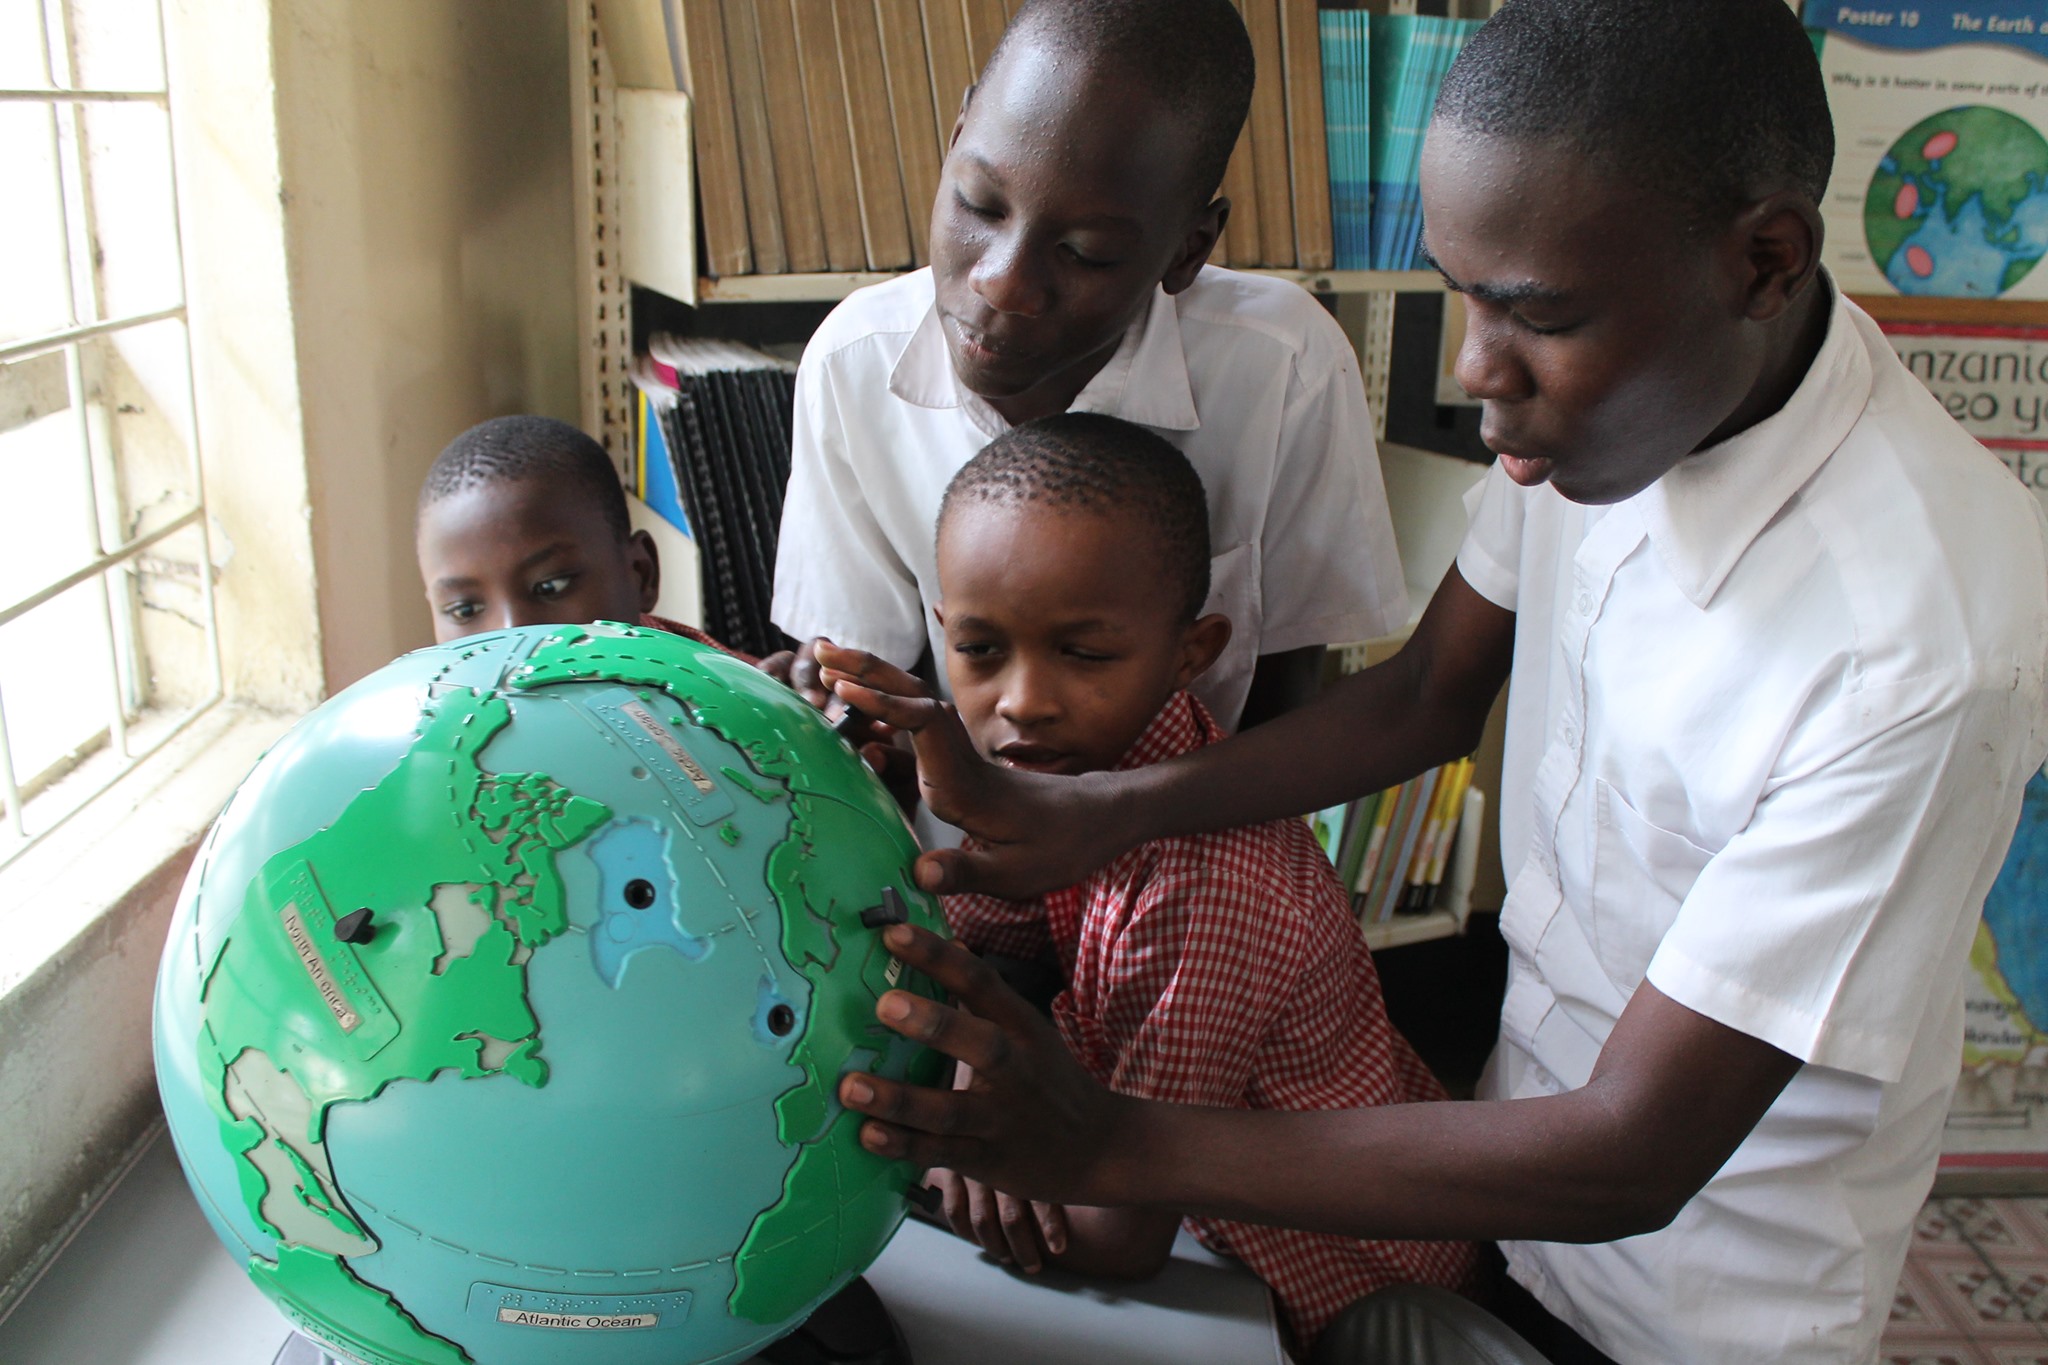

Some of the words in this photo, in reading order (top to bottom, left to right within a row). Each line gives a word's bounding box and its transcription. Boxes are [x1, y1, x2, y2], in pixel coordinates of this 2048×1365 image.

[1837, 6, 1894, 26] Poster
[1900, 9, 1920, 28] 10
[1952, 13, 1983, 32] The
[1987, 15, 2035, 34] Earth
[1932, 391, 1999, 421] eo
[285, 914, 312, 958] North
[515, 1312, 580, 1328] Atlantic
[586, 1316, 642, 1328] Ocean
